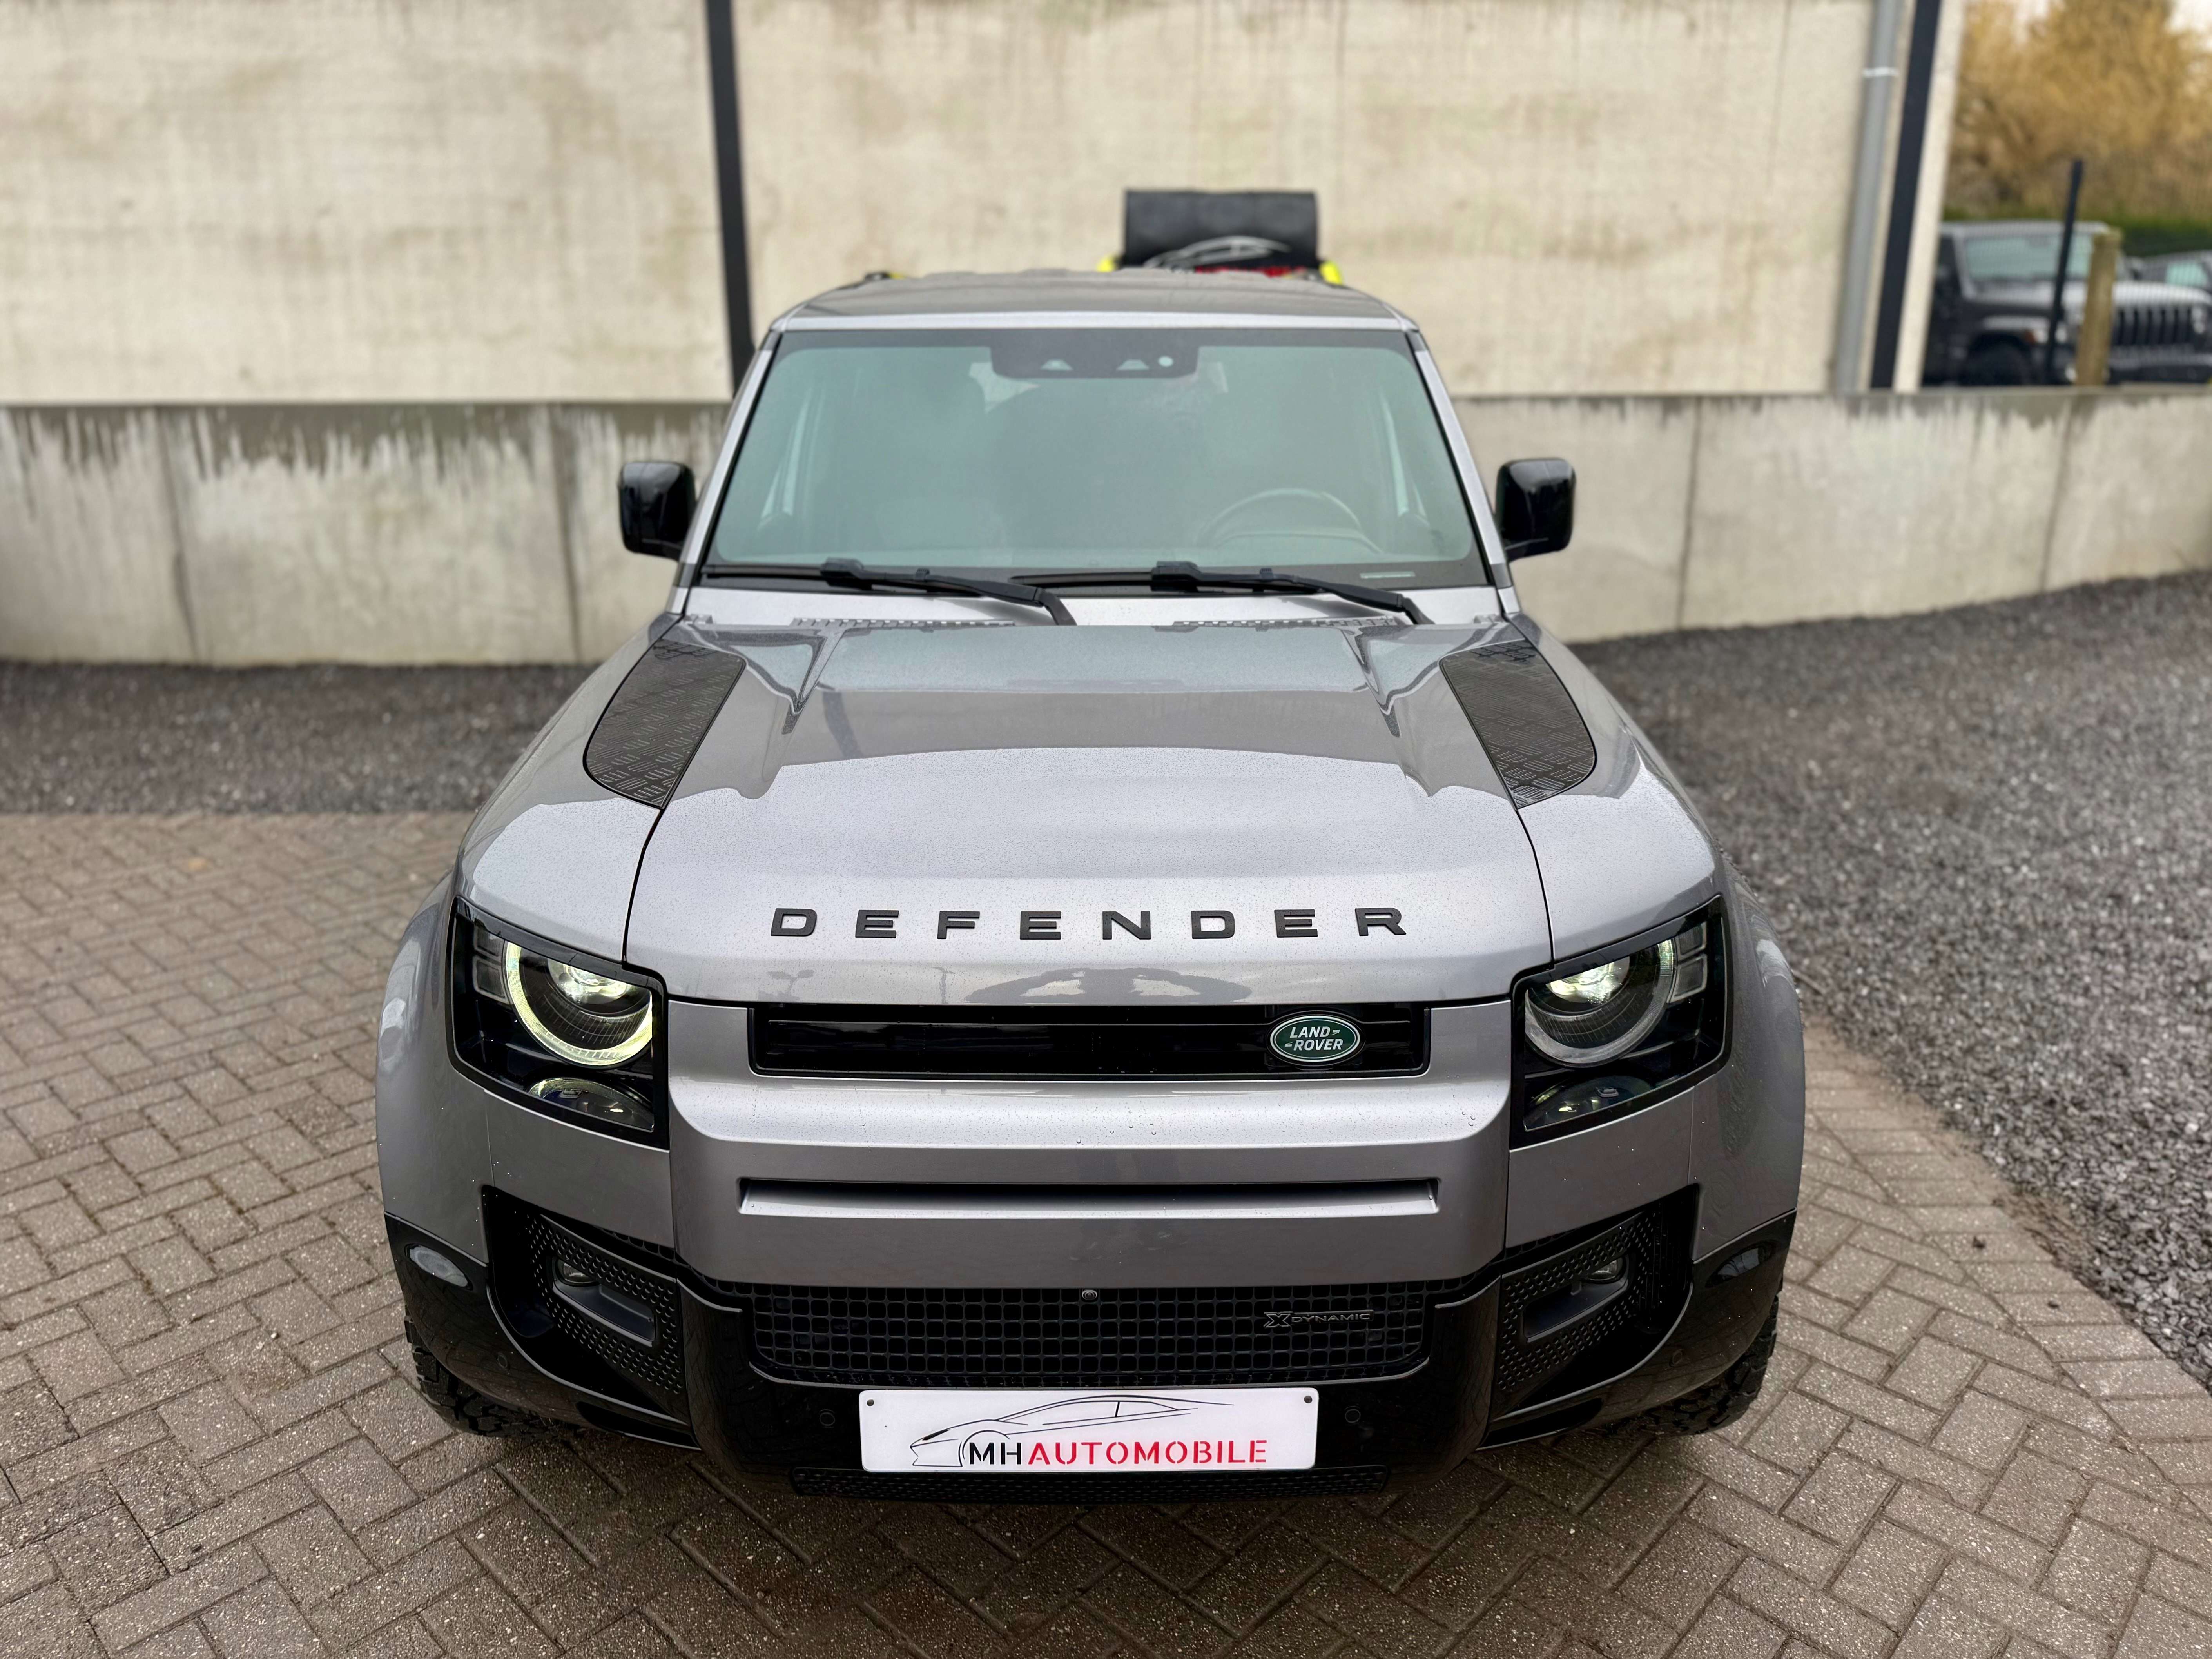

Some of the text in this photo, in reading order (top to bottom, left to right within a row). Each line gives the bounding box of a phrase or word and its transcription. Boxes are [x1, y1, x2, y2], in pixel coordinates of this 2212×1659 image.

[770, 907, 1407, 940] DEFENDER
[1289, 1026, 1330, 1038] LAND
[1293, 1039, 1343, 1051] ROVER
